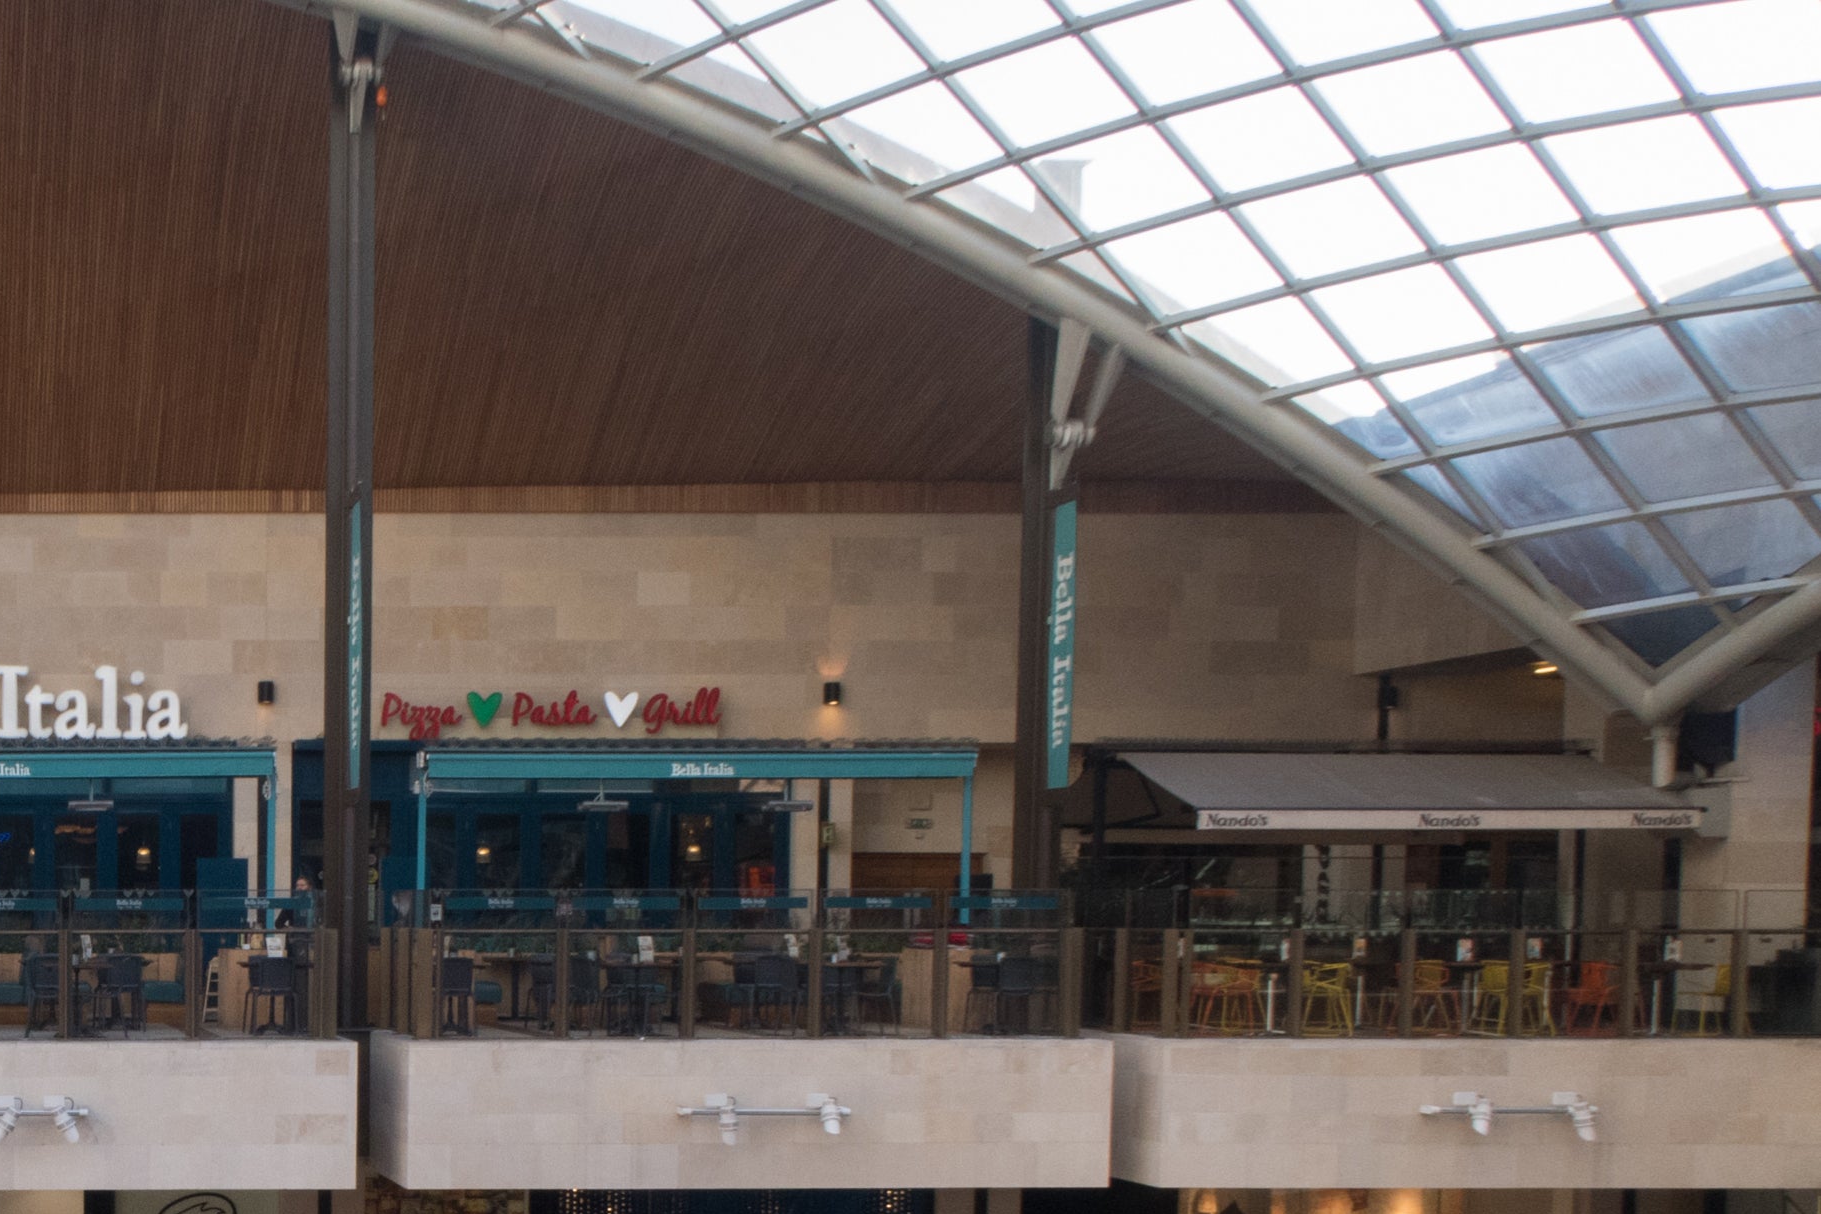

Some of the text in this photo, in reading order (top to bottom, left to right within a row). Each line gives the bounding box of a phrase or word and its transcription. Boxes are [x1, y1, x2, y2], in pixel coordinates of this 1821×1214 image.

[1052, 551, 1075, 748] Bella Italia
[381, 687, 723, 741] Pizza Pasta Grill
[0, 763, 30, 777] Italia
[671, 763, 735, 776] Bella Italia
[1204, 812, 1269, 829] Nando's
[1417, 812, 1481, 829] Nando's
[1630, 811, 1694, 827] Nando's
